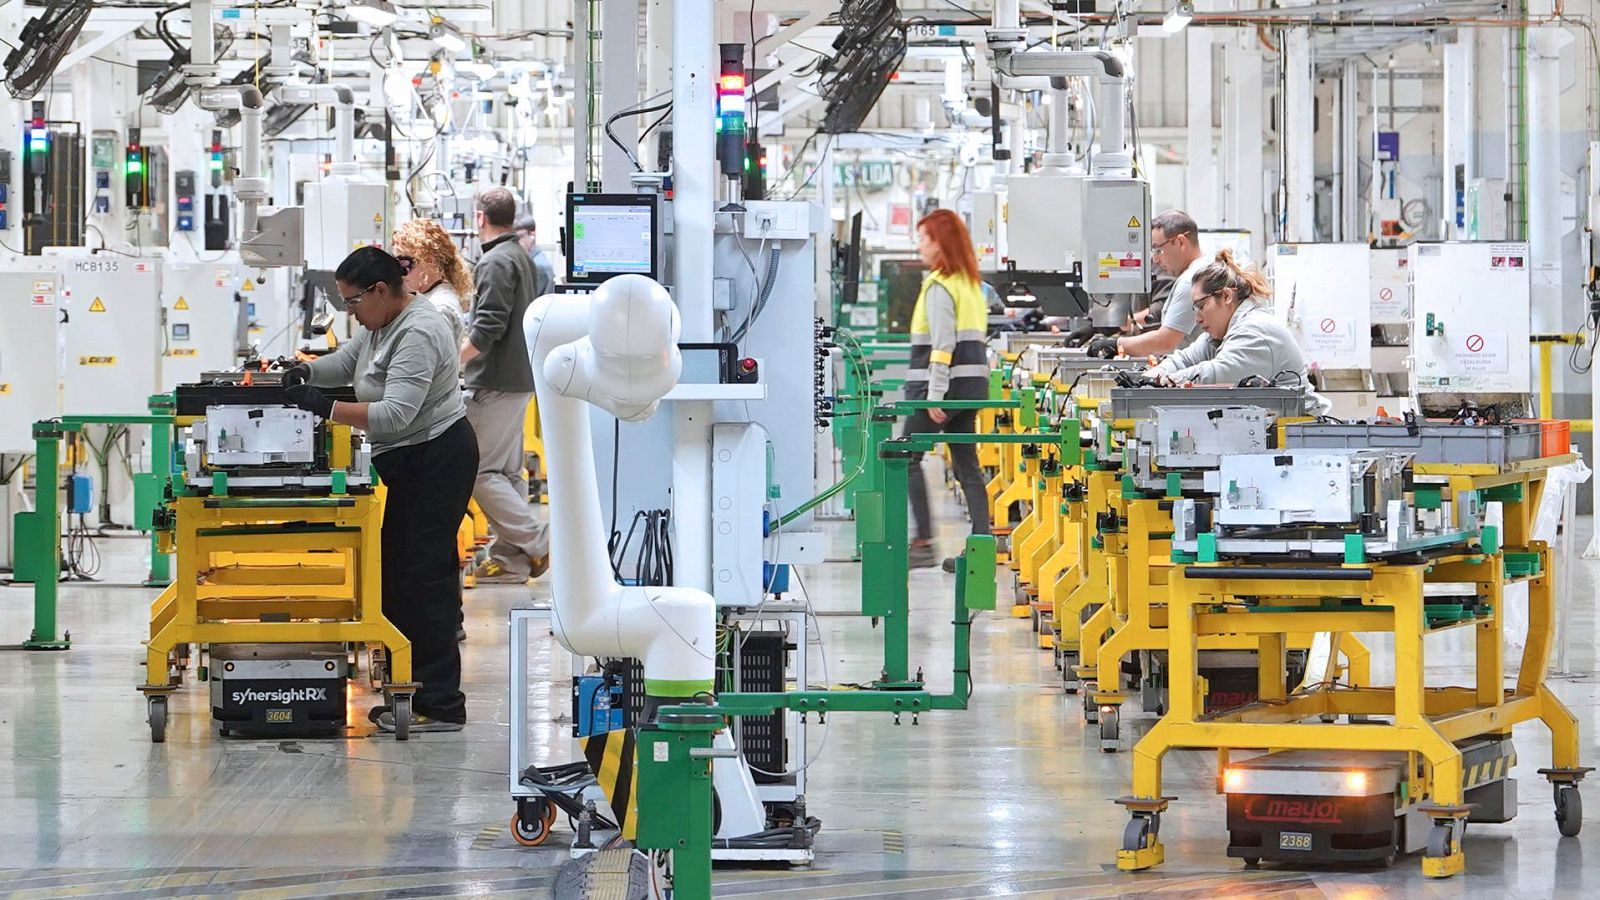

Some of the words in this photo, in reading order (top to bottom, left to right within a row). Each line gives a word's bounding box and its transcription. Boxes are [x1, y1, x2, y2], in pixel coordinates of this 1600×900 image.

[845, 164, 893, 185] SLIDA
[75, 262, 119, 272] MCB135
[232, 688, 328, 705] synersightRX
[267, 711, 291, 721] 3604
[1281, 835, 1311, 848] 2388
